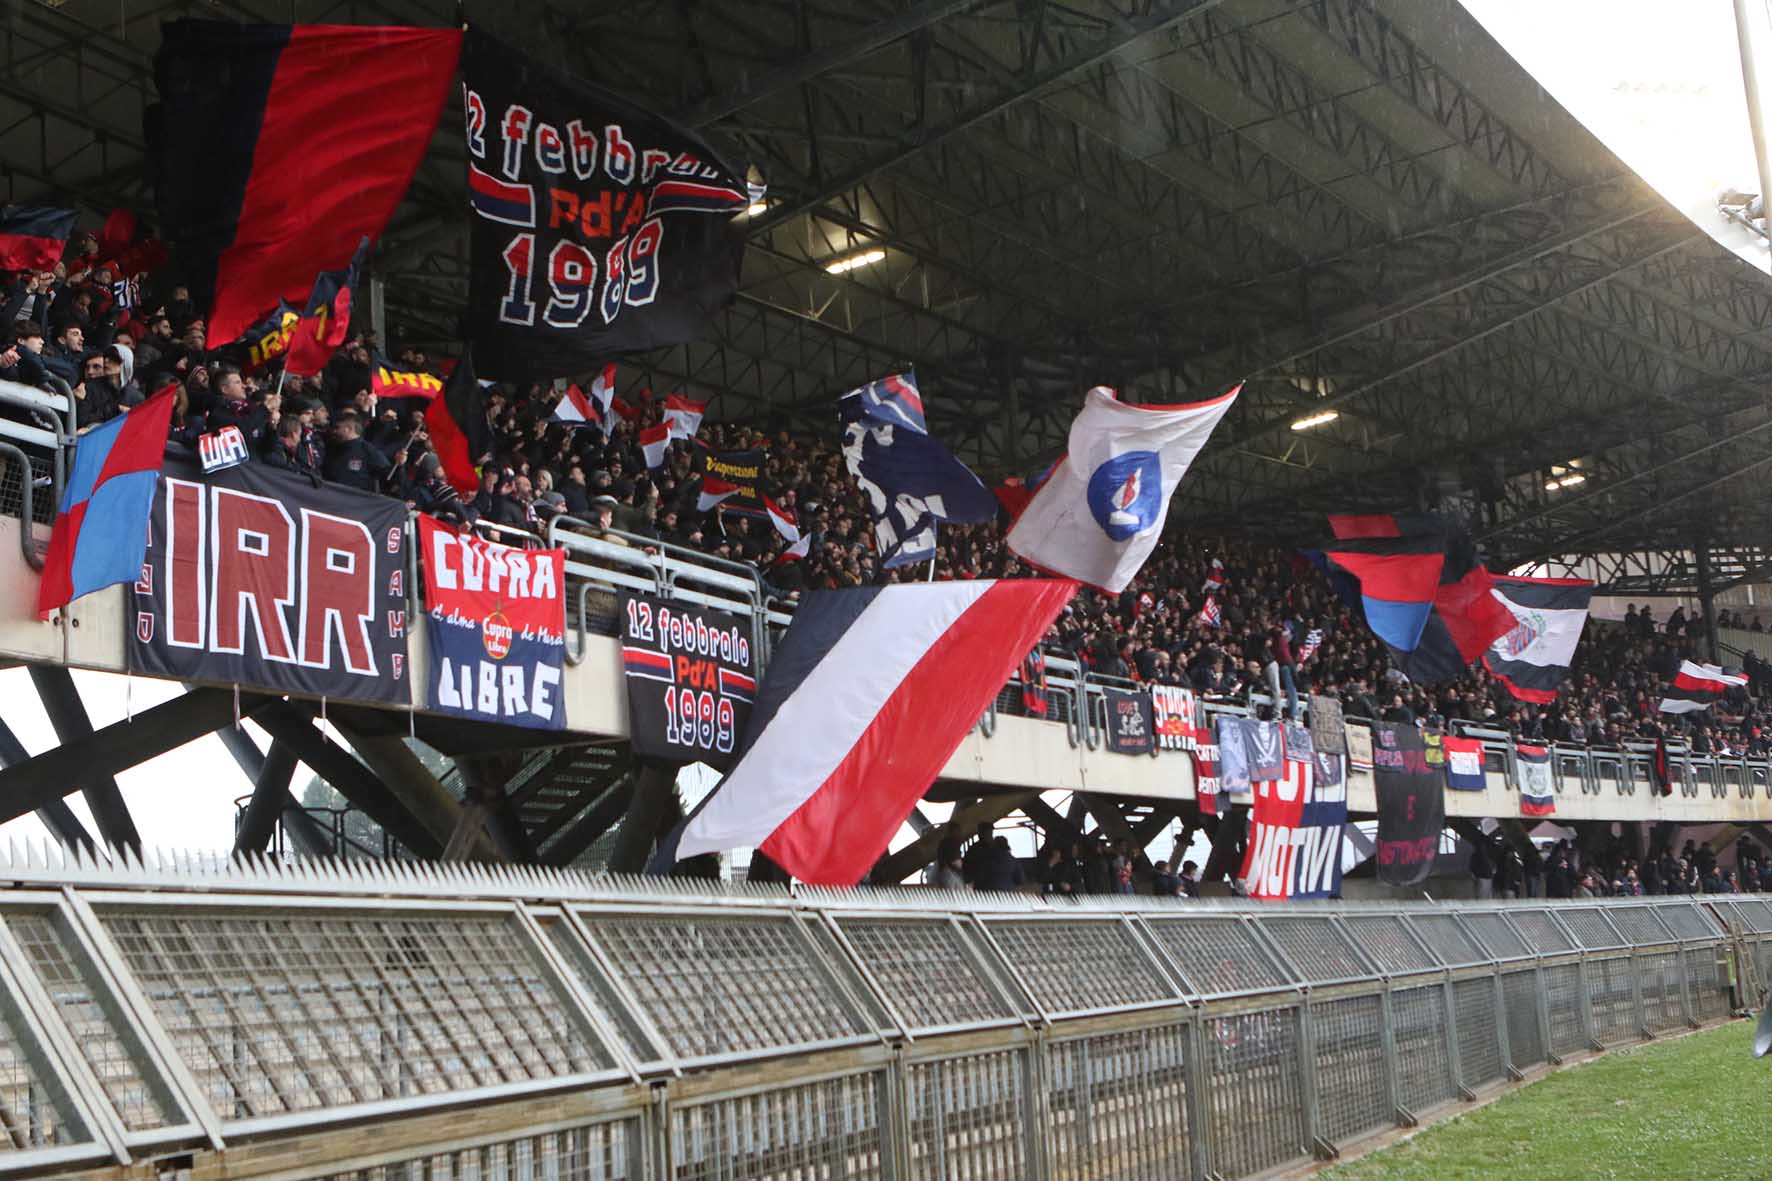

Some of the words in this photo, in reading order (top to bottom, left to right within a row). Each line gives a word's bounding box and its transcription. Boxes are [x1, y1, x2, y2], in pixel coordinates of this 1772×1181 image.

[500, 217, 664, 327] 1989
[165, 476, 379, 677] IRR
[433, 530, 557, 599] CUPRA
[482, 617, 513, 641] Cupra
[627, 599, 654, 641] 12
[658, 608, 749, 667] febbraio
[438, 657, 561, 721] LIBRE
[676, 655, 717, 690] Pd'A
[664, 685, 735, 753] 1989
